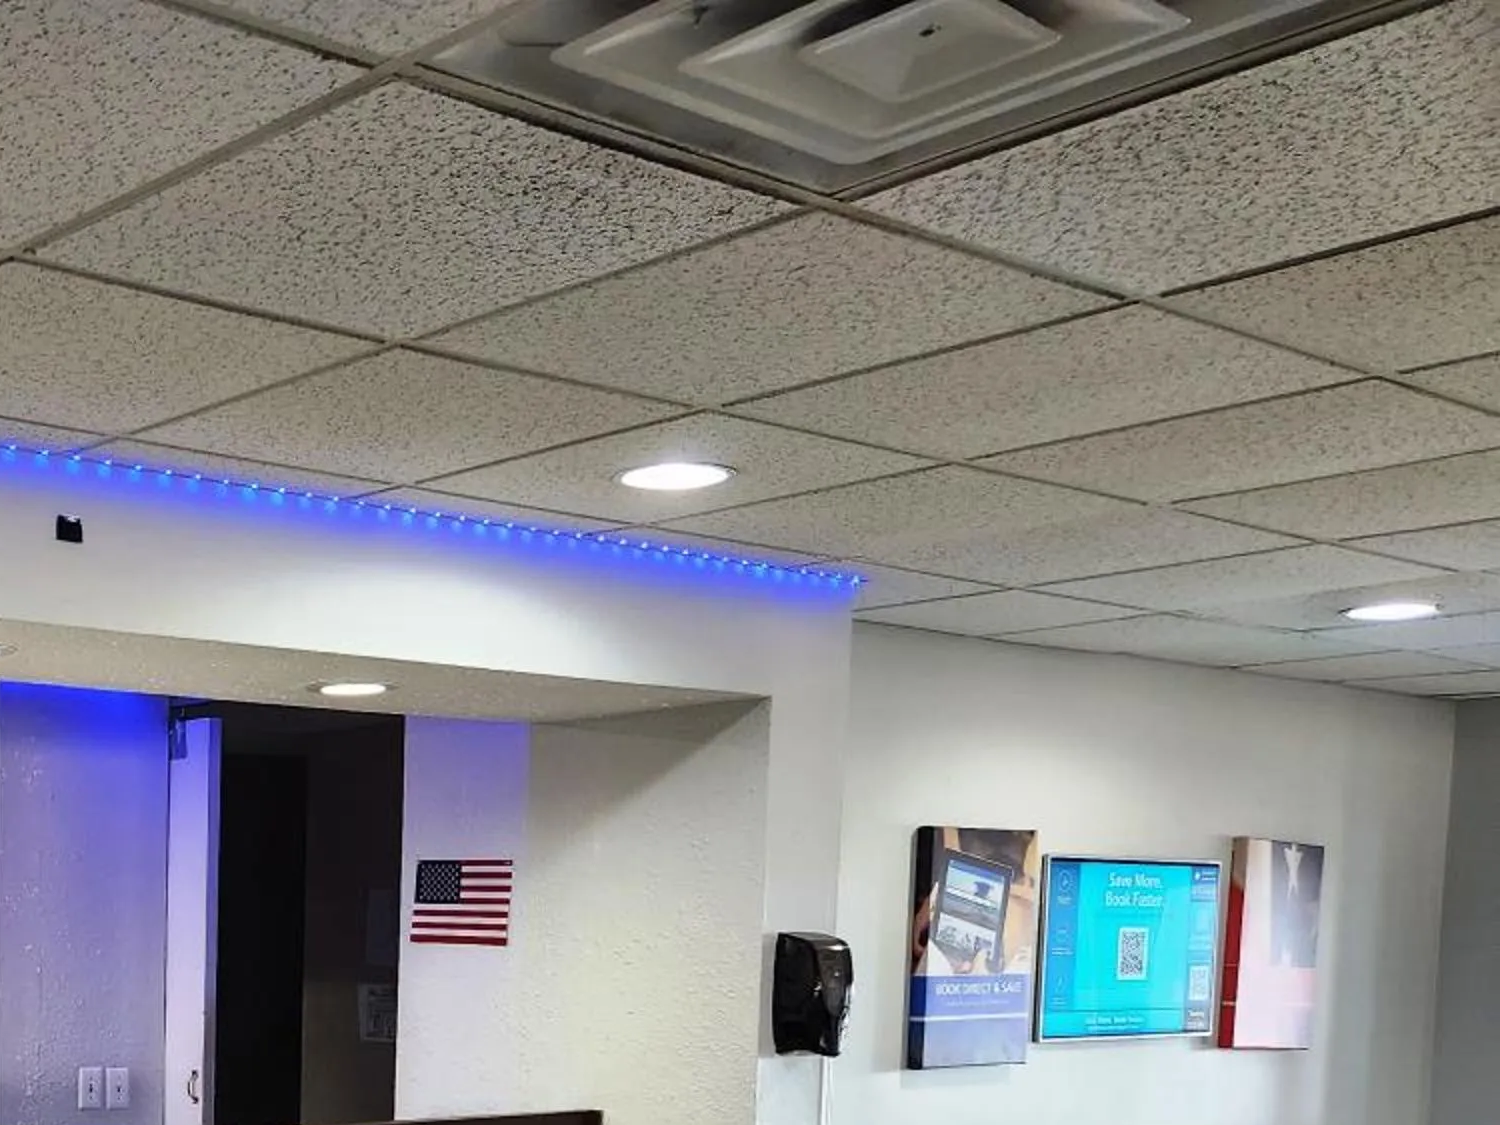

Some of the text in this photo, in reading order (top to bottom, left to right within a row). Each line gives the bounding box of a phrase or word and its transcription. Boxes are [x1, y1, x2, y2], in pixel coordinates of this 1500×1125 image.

[1109, 872, 1132, 888] Save
[1105, 891, 1131, 906] Book
[936, 982, 961, 995] BOOK
[963, 981, 990, 995] DIRECT
